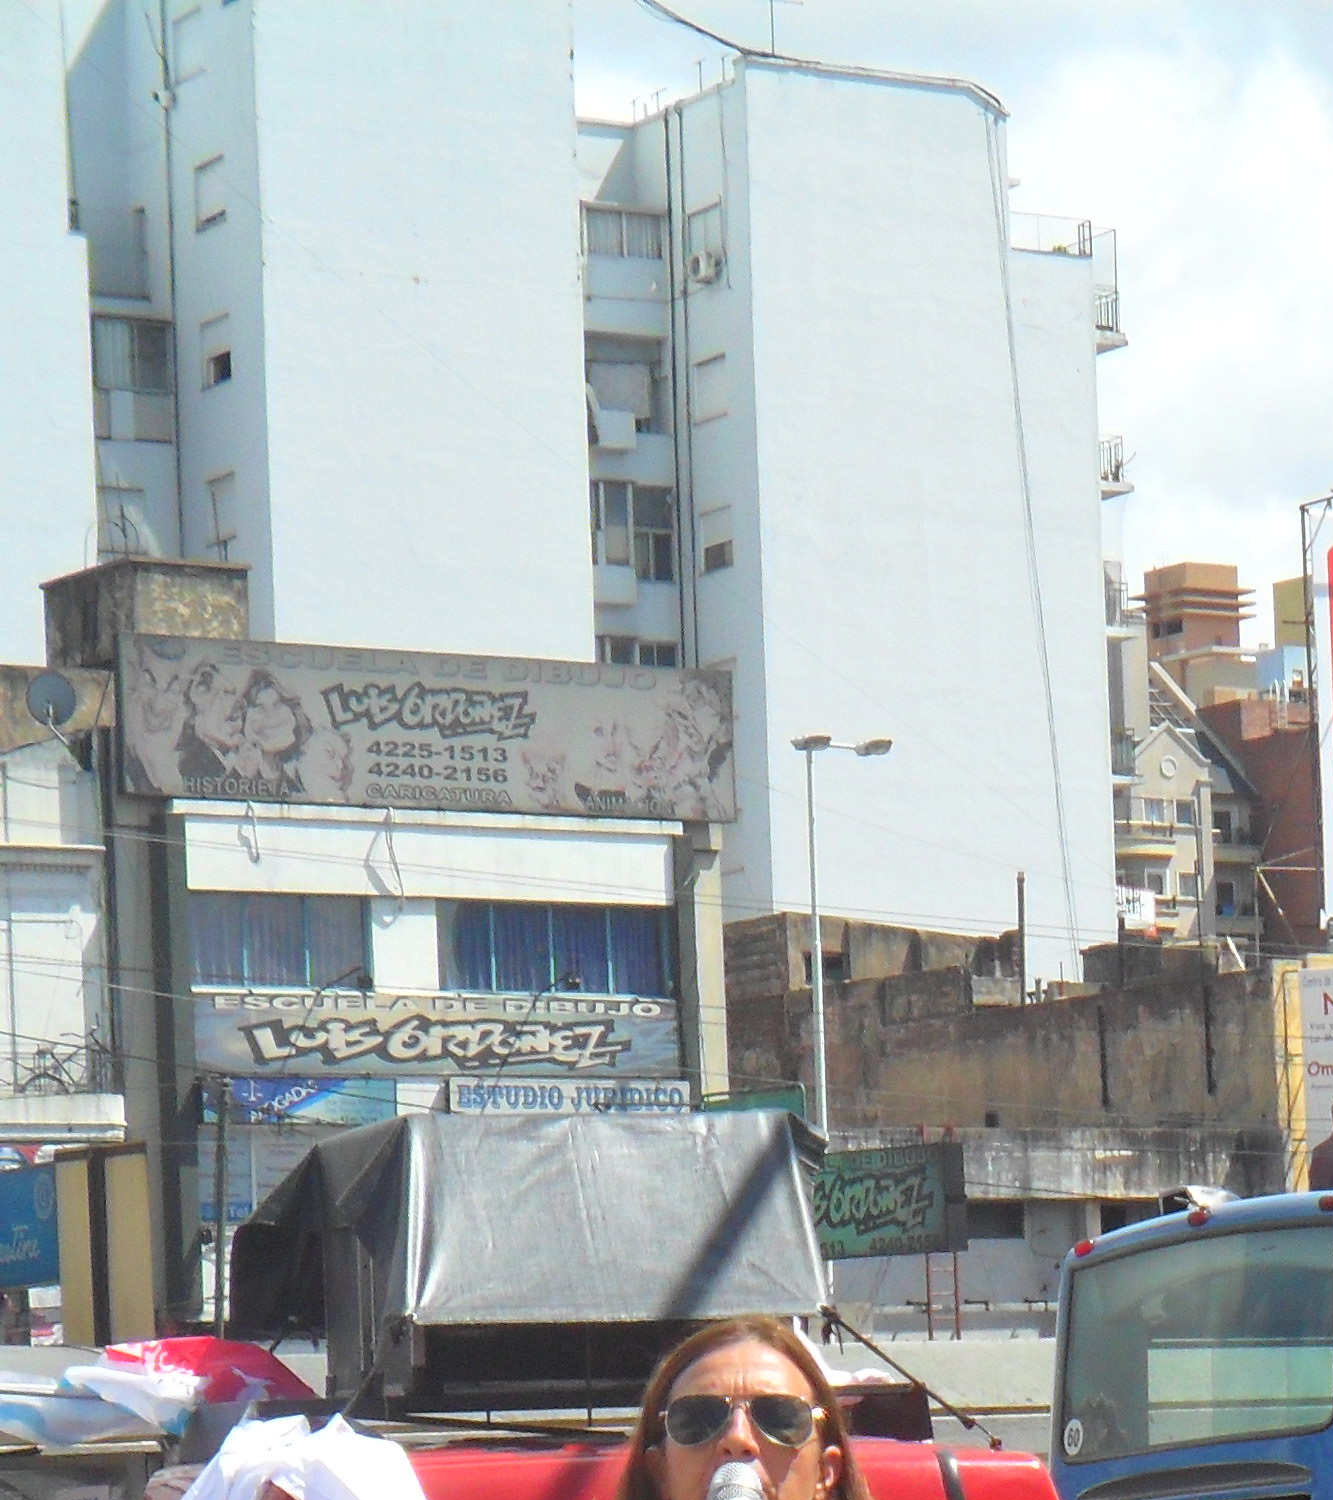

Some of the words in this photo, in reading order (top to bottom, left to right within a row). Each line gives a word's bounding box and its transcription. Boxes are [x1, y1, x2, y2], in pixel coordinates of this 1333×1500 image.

[222, 647, 419, 675] ESCUELA
[432, 659, 488, 681] DE
[502, 660, 657, 691] DIBUJO
[366, 741, 508, 763] 4225-1513
[367, 763, 508, 783] 4240-2156
[181, 777, 291, 797] HISTORIETA
[366, 783, 513, 805] CARICATURA
[213, 995, 420, 1011] ESCUELA
[434, 996, 488, 1013] DE
[504, 999, 662, 1016] DIBUJO
[456, 1083, 565, 1110] ESTUDIO
[570, 1085, 685, 1114] JURIDICO
[1067, 1427, 1080, 1448] 60
